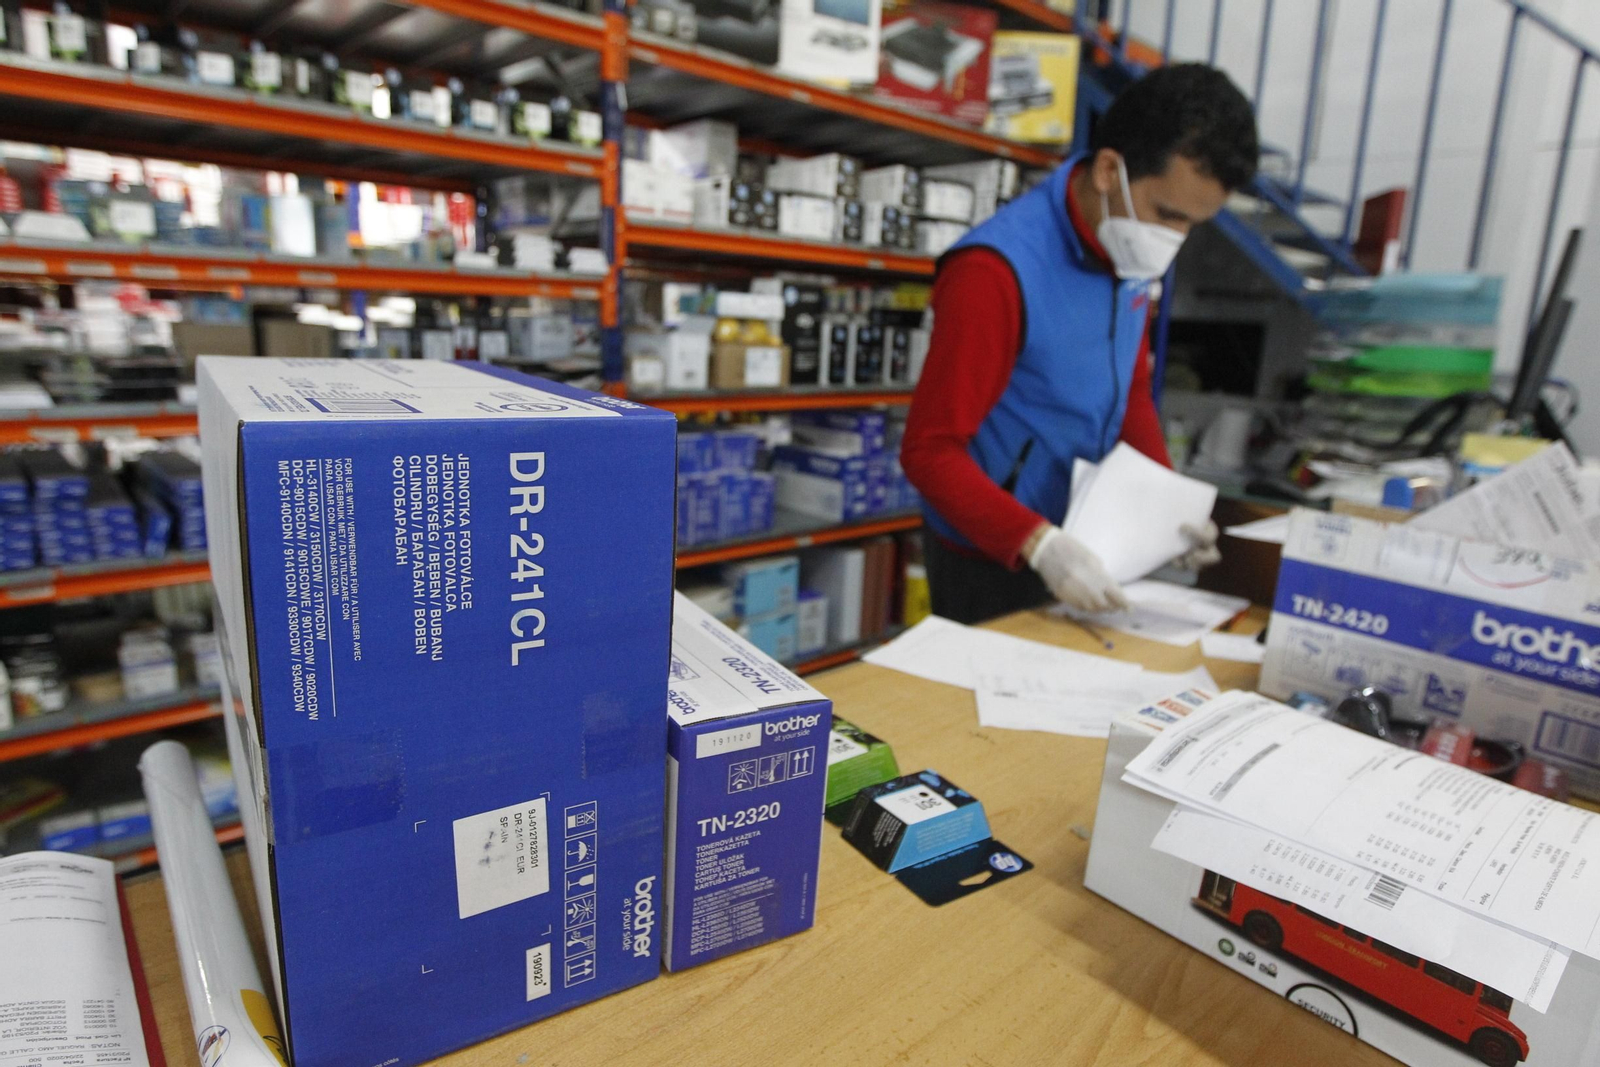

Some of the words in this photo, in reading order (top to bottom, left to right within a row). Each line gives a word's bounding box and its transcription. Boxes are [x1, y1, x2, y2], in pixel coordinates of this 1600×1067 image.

[325, 459, 333, 481] PARA
[334, 458, 343, 482] VOOR
[345, 477, 354, 494] USE
[409, 455, 422, 520] CILINDRU
[278, 460, 294, 540] MFC-9140CDN
[292, 460, 308, 540] DCP-9015CDW
[306, 460, 320, 522] HL-3140CW
[326, 482, 334, 506] USAR
[336, 484, 346, 520] GEBRUIK
[346, 495, 354, 517] WITH
[426, 454, 442, 542] DOBEGYSÉG
[442, 454, 454, 528] JEDNOTKA
[458, 454, 470, 527] JEDNOTKA
[328, 507, 336, 525] CON
[338, 522, 346, 538] MET
[392, 456, 408, 566] ФОТОБАРАБАН
[310, 532, 323, 582] 3150CDW
[329, 531, 337, 552] PARA
[339, 545, 347, 556] DA
[348, 522, 358, 577] VERWENDBAR
[509, 452, 546, 666] DR-241CL
[284, 548, 298, 598] 9141CDN
[298, 550, 312, 608] 9015CDWE
[330, 554, 338, 576] USAR
[340, 557, 350, 602] UTILIZZARE
[412, 532, 425, 598] БАРАБАН
[426, 552, 441, 598] BĘBEN
[444, 532, 456, 612] FOTOVALCA
[460, 530, 474, 610] FOTOVÁLCE
[331, 578, 340, 596] COM
[350, 578, 359, 596] FÜR
[288, 606, 302, 656] 9330CDW
[314, 592, 326, 640] 3170CDW
[342, 604, 350, 620] CON
[352, 607, 360, 640] UTILISER
[414, 608, 427, 654] BOBEN
[1292, 593, 1389, 636] TN-2420
[302, 616, 316, 664] 9017CDW
[354, 642, 362, 662] AVEC
[430, 608, 442, 661] BUBANJ
[292, 664, 305, 712] 9340CDW
[722, 656, 782, 694] TN-2320
[306, 673, 318, 720] 9020CDW
[765, 714, 821, 736] brother
[697, 802, 780, 837] TN-2320
[734, 830, 761, 842] KAZETA
[695, 861, 718, 872] TONER
[696, 854, 718, 865] TONER
[722, 860, 744, 873] TONER
[738, 866, 760, 878] TONER
[621, 908, 632, 930] your
[623, 897, 632, 907] at
[634, 875, 656, 958] brother
[622, 931, 632, 951] side
